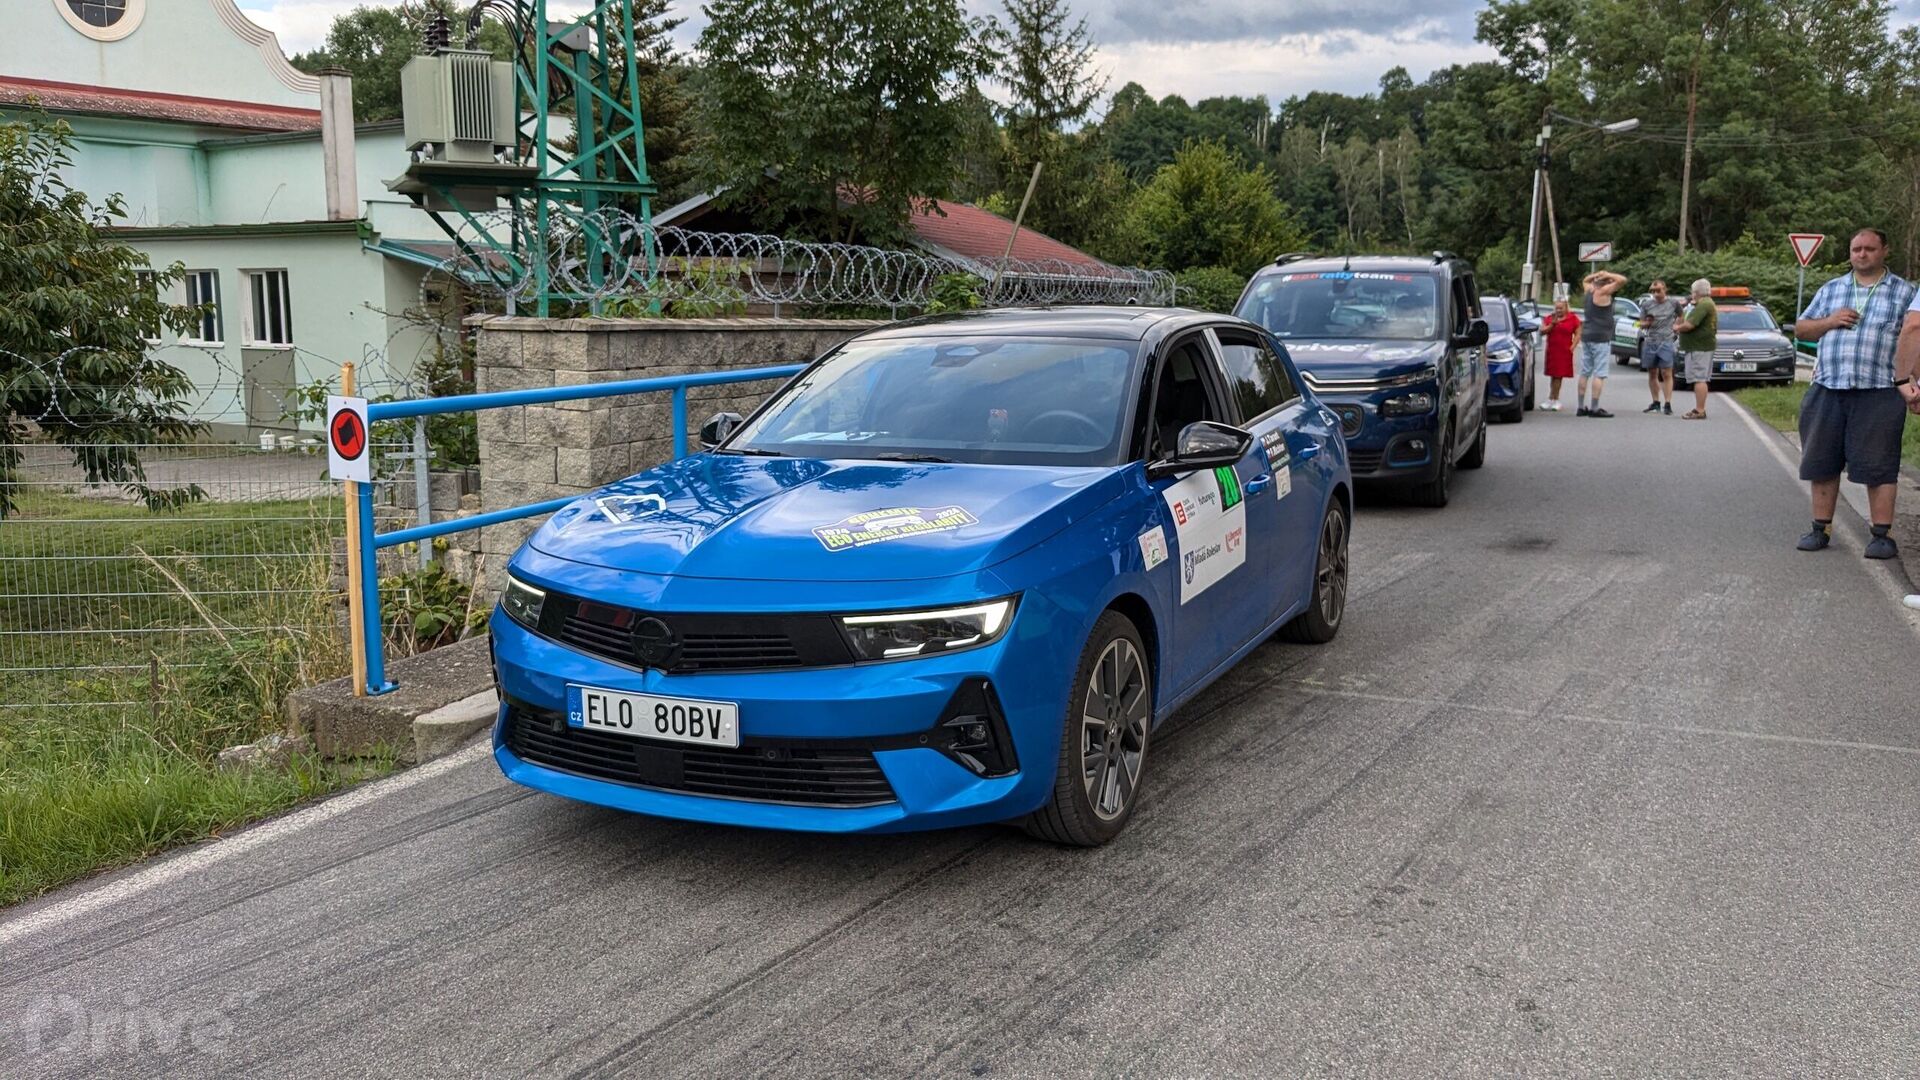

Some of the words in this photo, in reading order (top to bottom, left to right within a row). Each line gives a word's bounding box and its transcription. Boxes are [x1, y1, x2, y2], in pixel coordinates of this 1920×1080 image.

[823, 533, 853, 548] ECO
[851, 528, 899, 542] ENERGY
[902, 513, 969, 533] REGULARITY
[570, 711, 582, 722] CZ
[654, 703, 722, 739] 80BV
